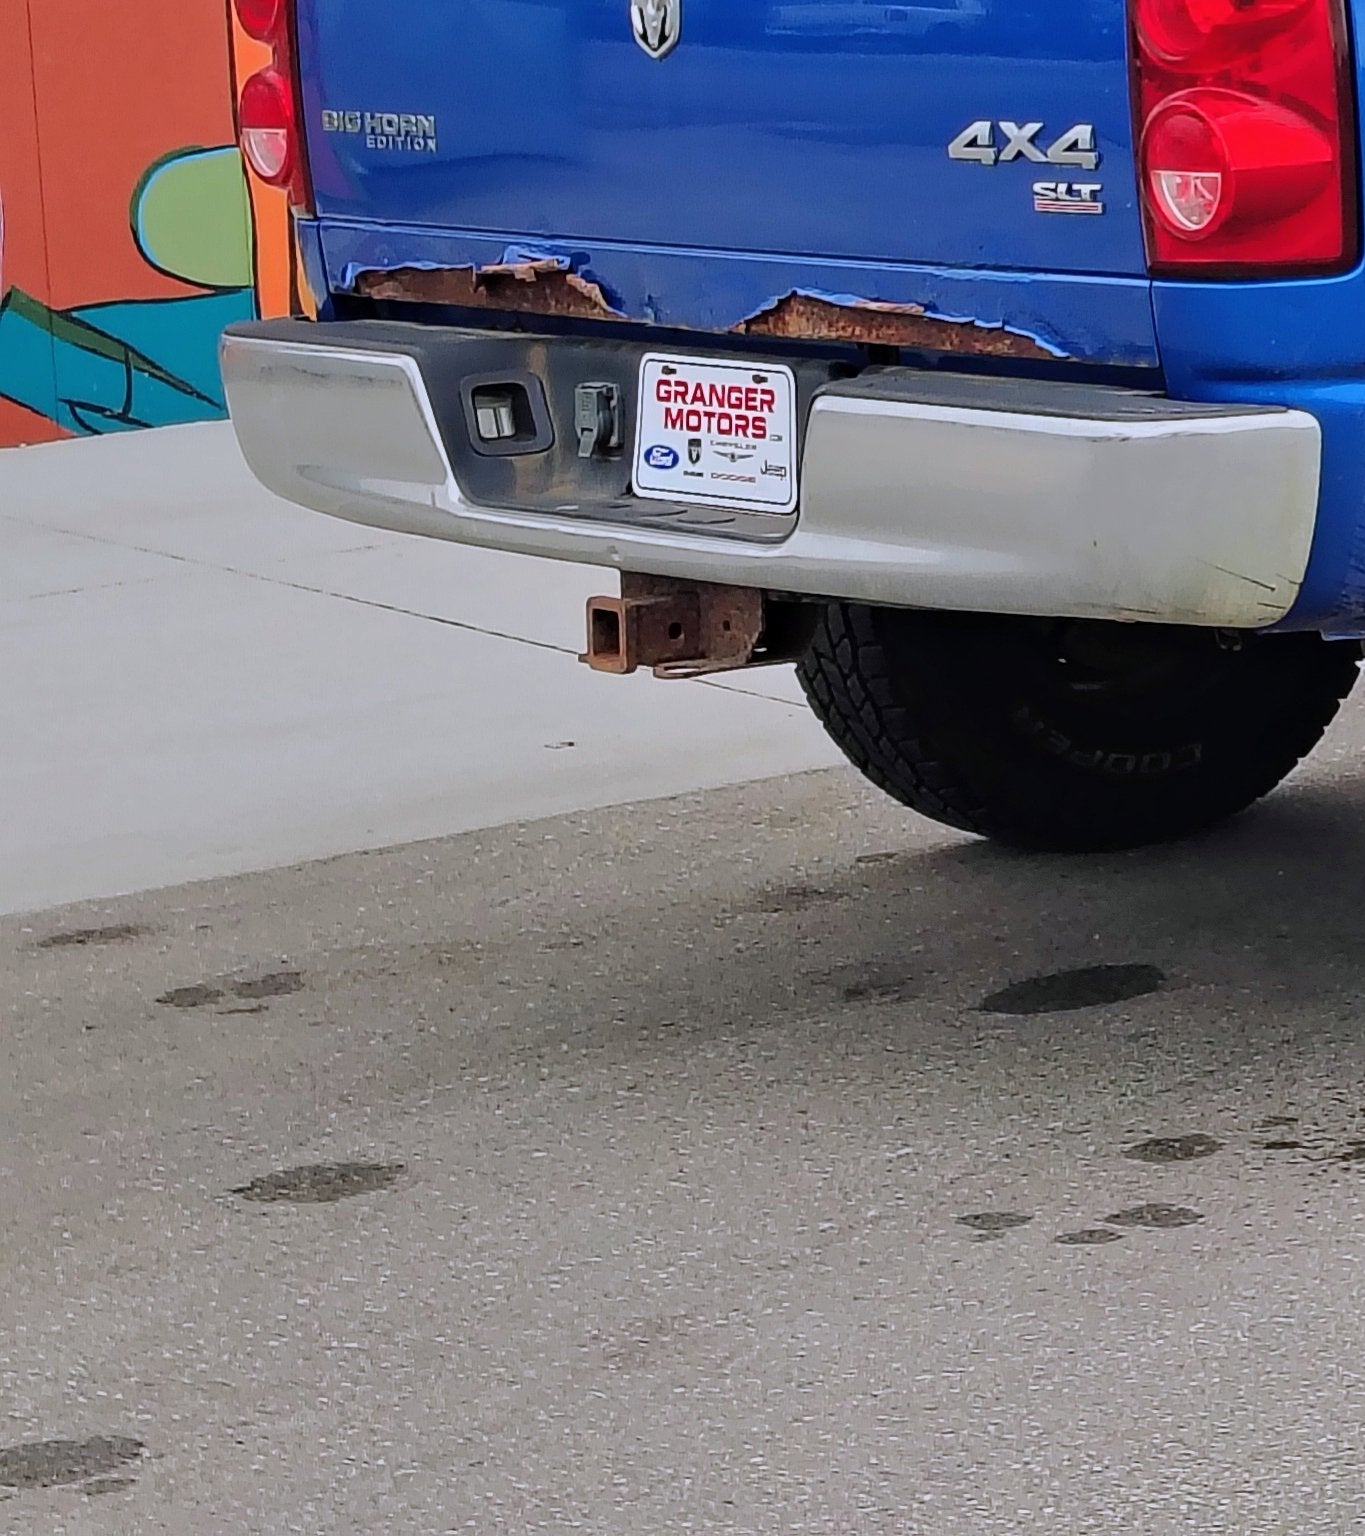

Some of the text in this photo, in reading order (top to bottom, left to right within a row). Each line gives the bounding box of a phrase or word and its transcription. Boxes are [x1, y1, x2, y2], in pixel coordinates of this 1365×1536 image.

[321, 109, 436, 138] BIG HORN
[366, 135, 437, 154] EDITION
[1032, 181, 1102, 201] SLT
[655, 378, 776, 414] GRANGER
[663, 406, 767, 440] MOTORS
